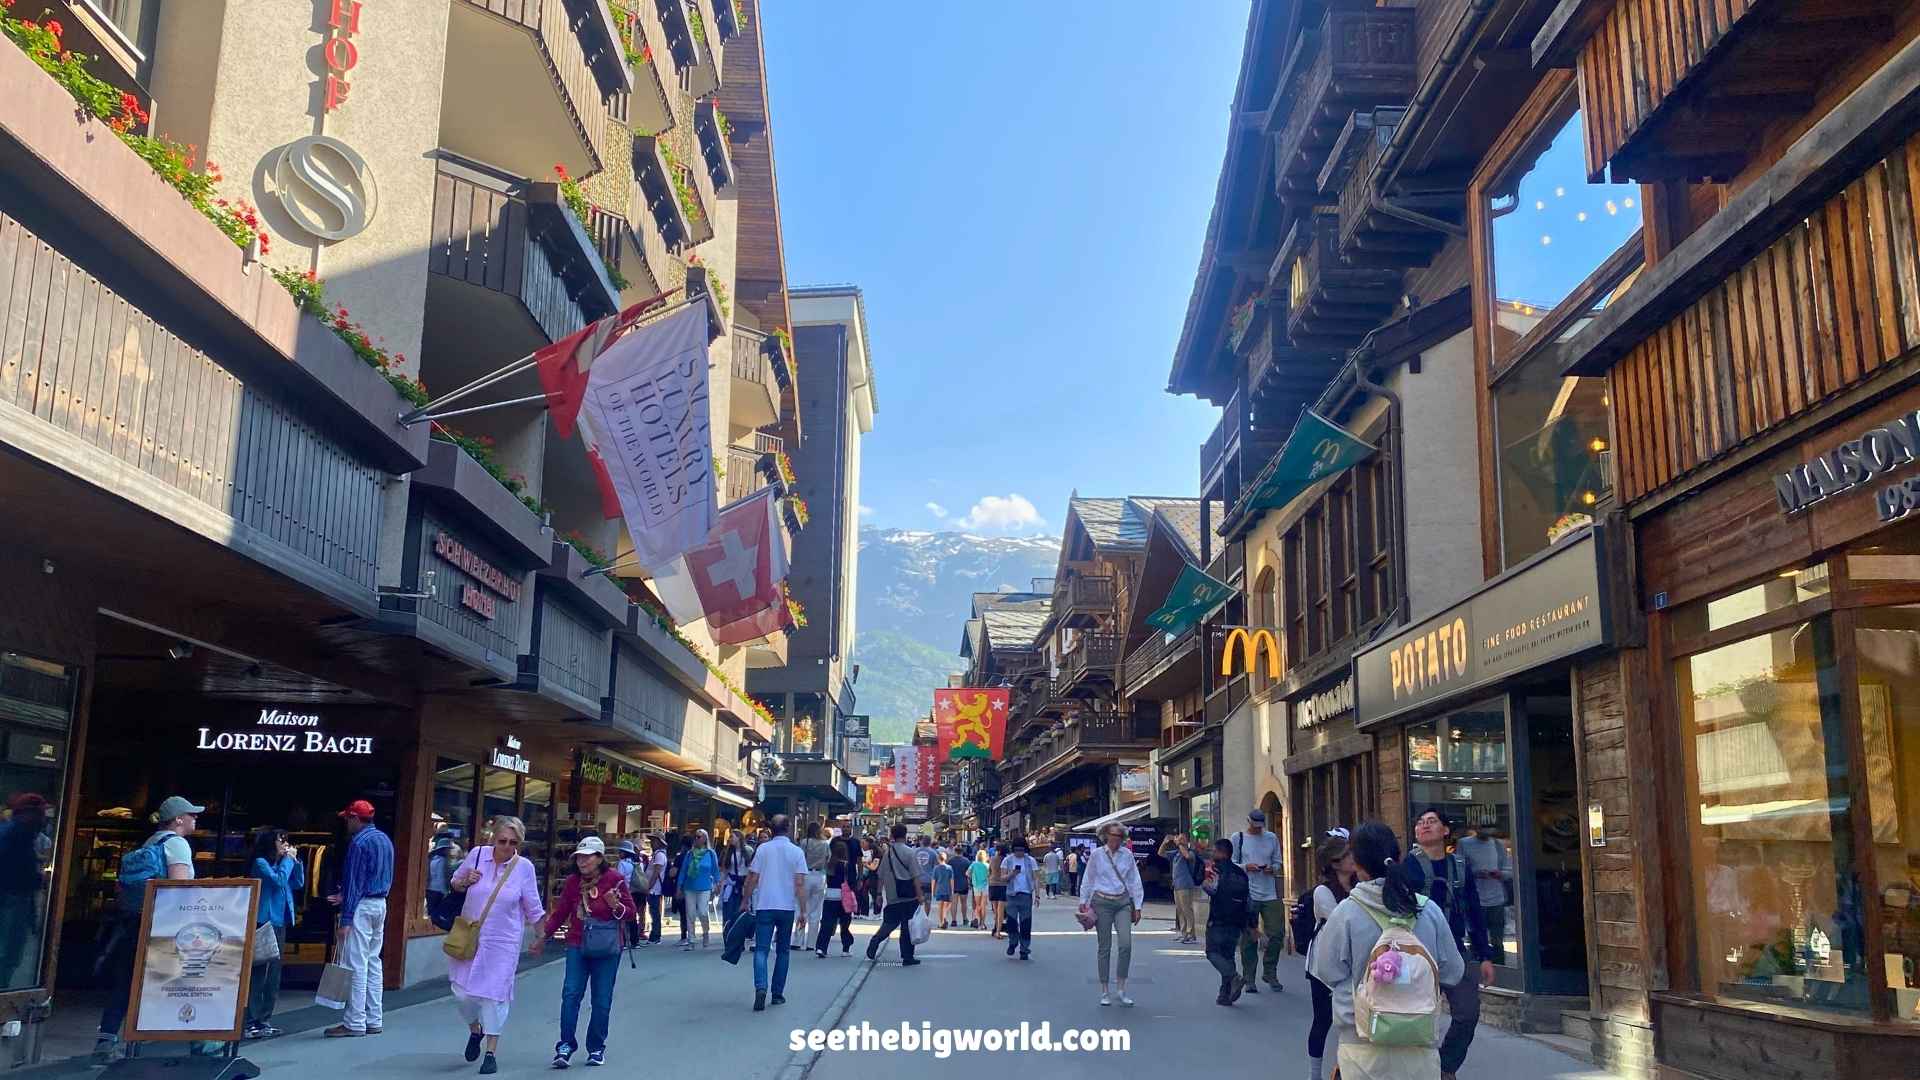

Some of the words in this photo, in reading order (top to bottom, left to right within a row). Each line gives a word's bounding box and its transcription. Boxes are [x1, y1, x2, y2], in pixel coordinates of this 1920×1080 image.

[608, 391, 625, 413] OF
[617, 416, 642, 452] THE
[632, 445, 666, 517] WORLD
[629, 380, 688, 506] HOTELS
[655, 369, 709, 487] LUXURY
[1390, 616, 1467, 702] POTATO
[1482, 633, 1501, 649] FINE
[1505, 622, 1528, 640] FOOD
[1530, 595, 1590, 632] RESTAURANT
[256, 709, 320, 727] Maison
